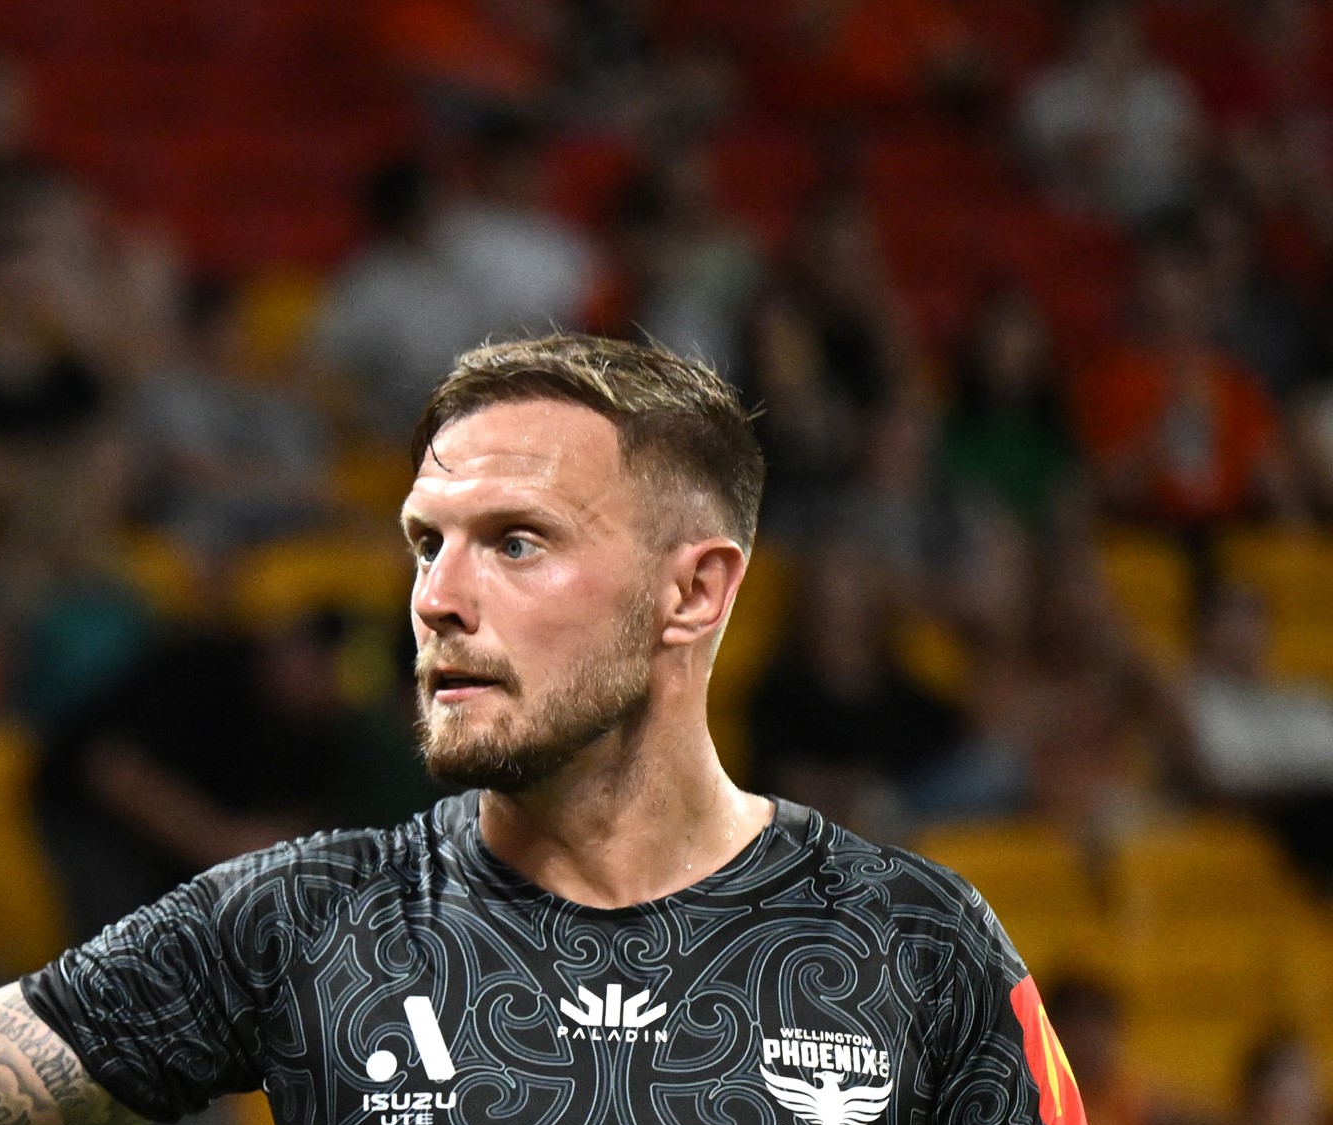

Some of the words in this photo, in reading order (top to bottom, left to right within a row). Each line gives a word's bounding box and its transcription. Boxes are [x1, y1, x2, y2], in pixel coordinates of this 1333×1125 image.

[557, 1025, 668, 1043] PALADIN
[780, 1028, 872, 1047] WELLINGTON
[763, 1038, 877, 1076] PHOENIX
[363, 1092, 457, 1111] ISUZU
